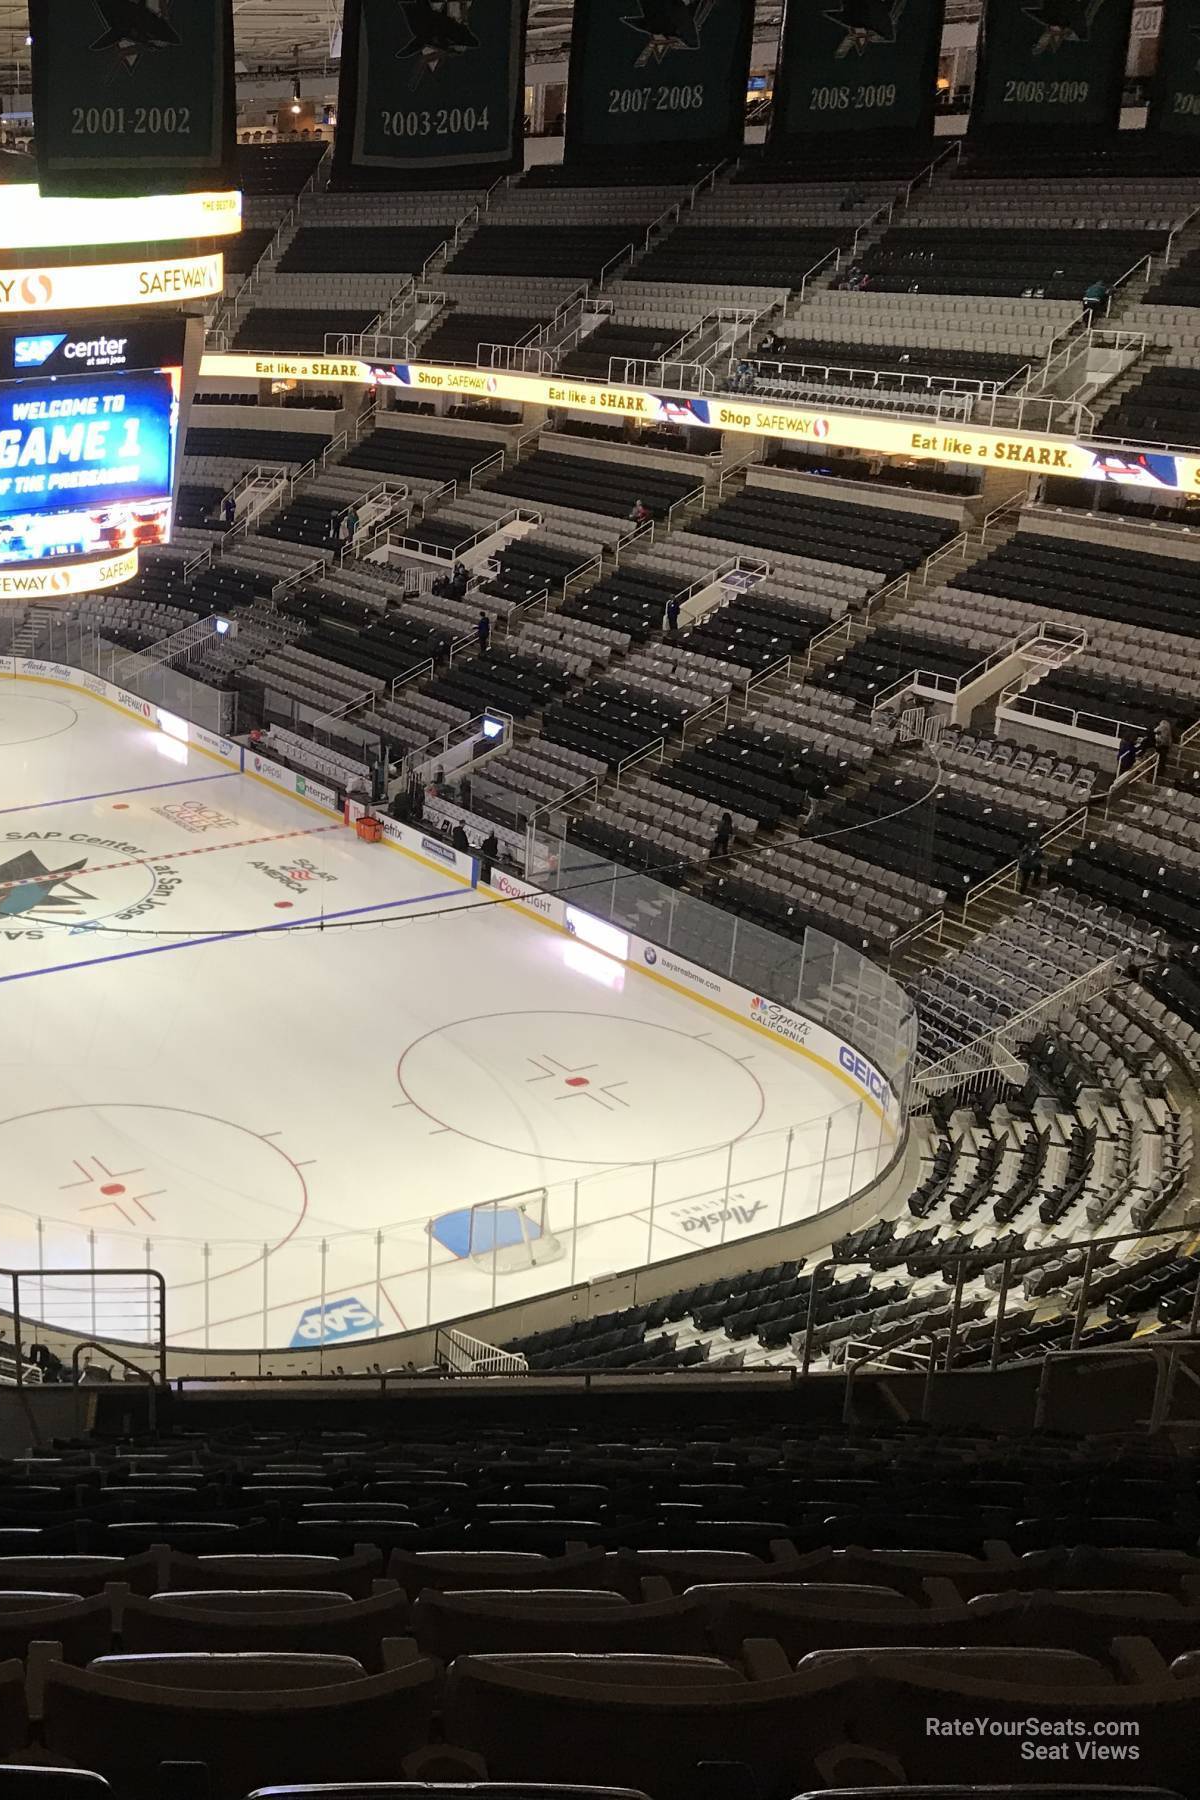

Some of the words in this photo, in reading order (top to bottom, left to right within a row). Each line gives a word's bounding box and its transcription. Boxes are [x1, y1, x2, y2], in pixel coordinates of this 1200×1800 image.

[608, 85, 704, 113] 2007-2008
[809, 83, 897, 111] 2008-2009
[1004, 80, 1088, 103] 2008-2009
[72, 107, 191, 135] 2001-2002
[382, 105, 490, 137] 2003-2004
[139, 265, 207, 295] SAFEWAY
[15, 339, 54, 363] SAP
[64, 336, 127, 358] center
[255, 362, 275, 374] Eat
[276, 362, 298, 375] like
[301, 367, 308, 375] a
[418, 371, 443, 387] Shop
[447, 374, 486, 390] SAFEWAY
[12, 397, 99, 420] WELCOME
[103, 395, 125, 413] TO
[548, 387, 565, 401] Eat
[568, 390, 587, 405] like
[590, 396, 596, 405] a
[720, 409, 750, 426] Shop
[756, 413, 811, 434] SAFEWAY
[118, 418, 141, 458] 1
[911, 433, 937, 450] Eat
[943, 437, 972, 456] like
[978, 446, 988, 457] a
[15, 474, 45, 494] THE
[117, 691, 143, 713] SAFEWAY
[5, 831, 62, 840] SAP
[69, 833, 148, 855] Center
[153, 864, 179, 876] at
[156, 877, 183, 897] San
[114, 897, 167, 920] Jose
[750, 1011, 806, 1045] CALIFORNIA
[767, 1004, 813, 1037] Sports
[681, 1200, 768, 1233] Alaska
[298, 1303, 374, 1339] SAP
